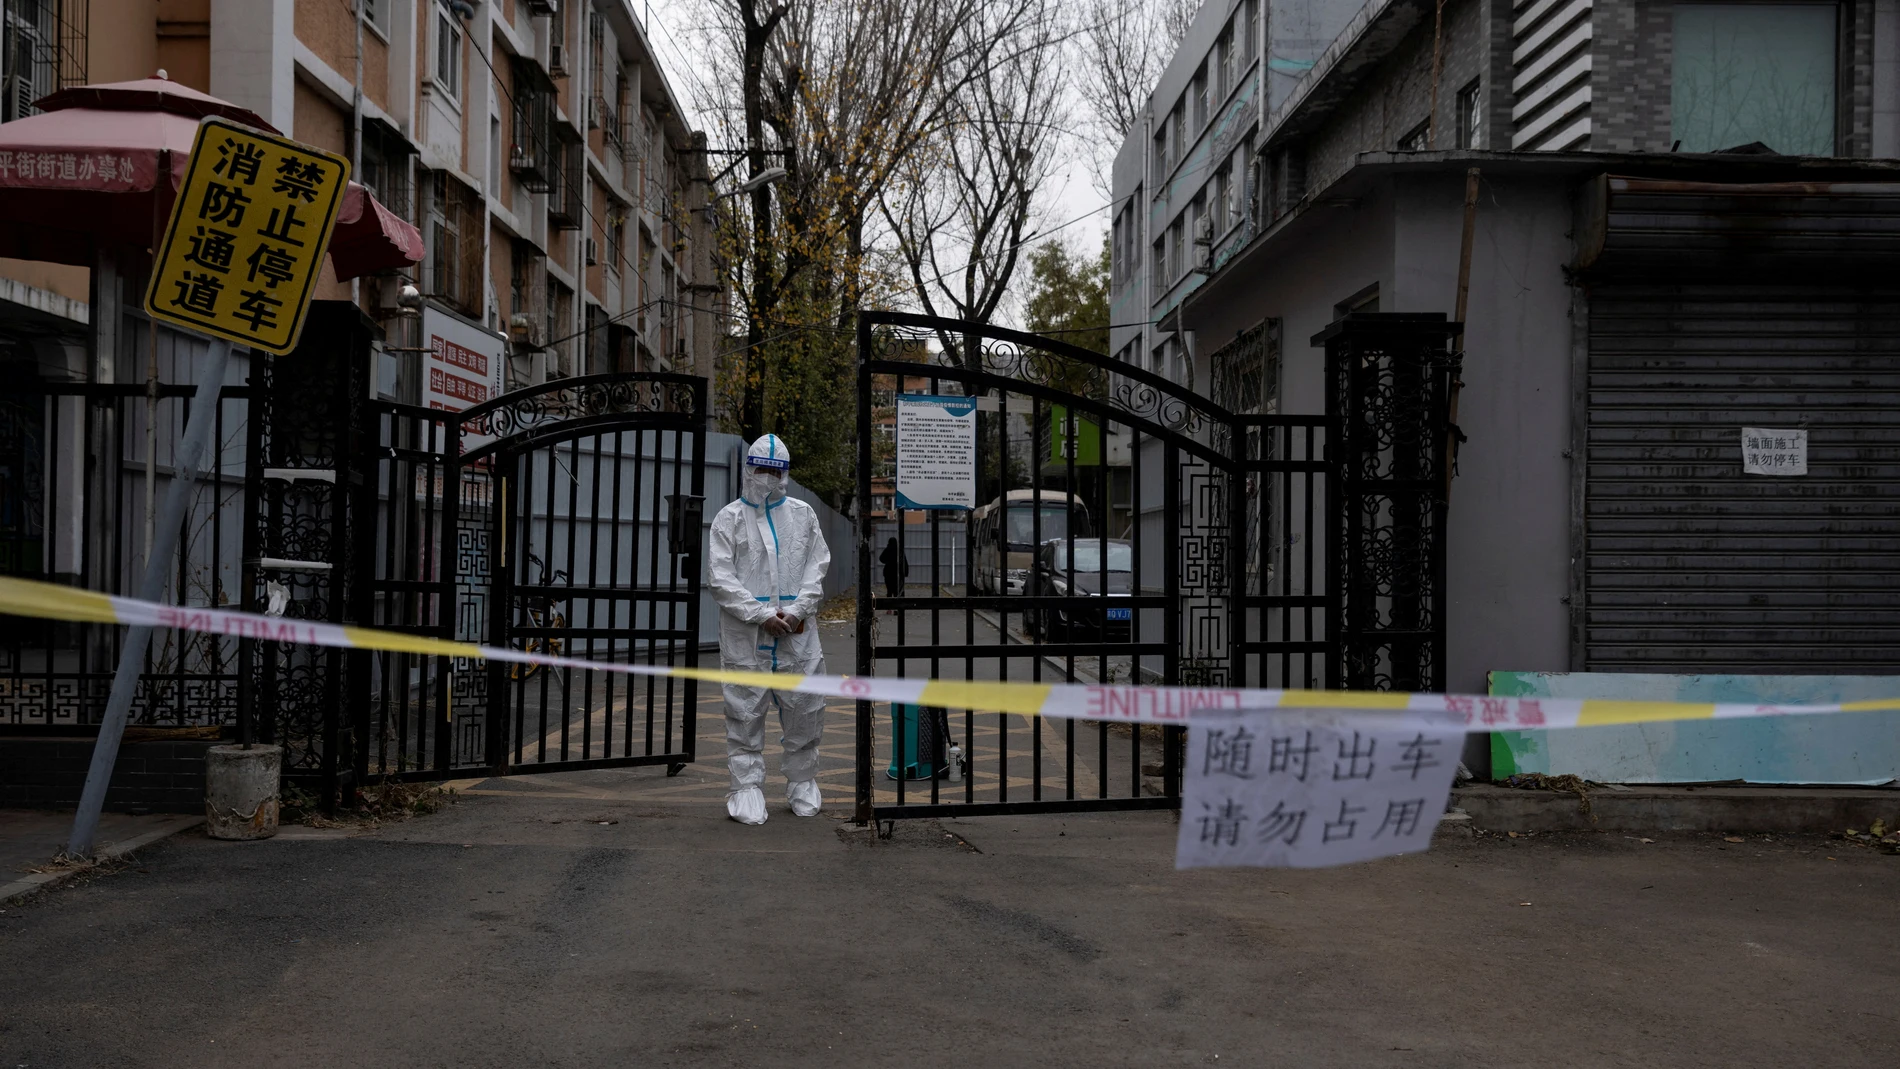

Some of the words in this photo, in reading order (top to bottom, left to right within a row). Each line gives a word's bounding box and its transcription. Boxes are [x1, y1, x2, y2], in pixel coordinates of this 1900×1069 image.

[0, 151, 134, 183] 平街街道办事处
[170, 137, 265, 318] 消防通道
[232, 156, 325, 332] 禁止停车
[1747, 437, 1800, 450] 墙面施工
[1748, 453, 1800, 467] 请勿停车
[1203, 725, 1441, 782] 随时出车
[1196, 797, 1424, 847] 请勿占用
